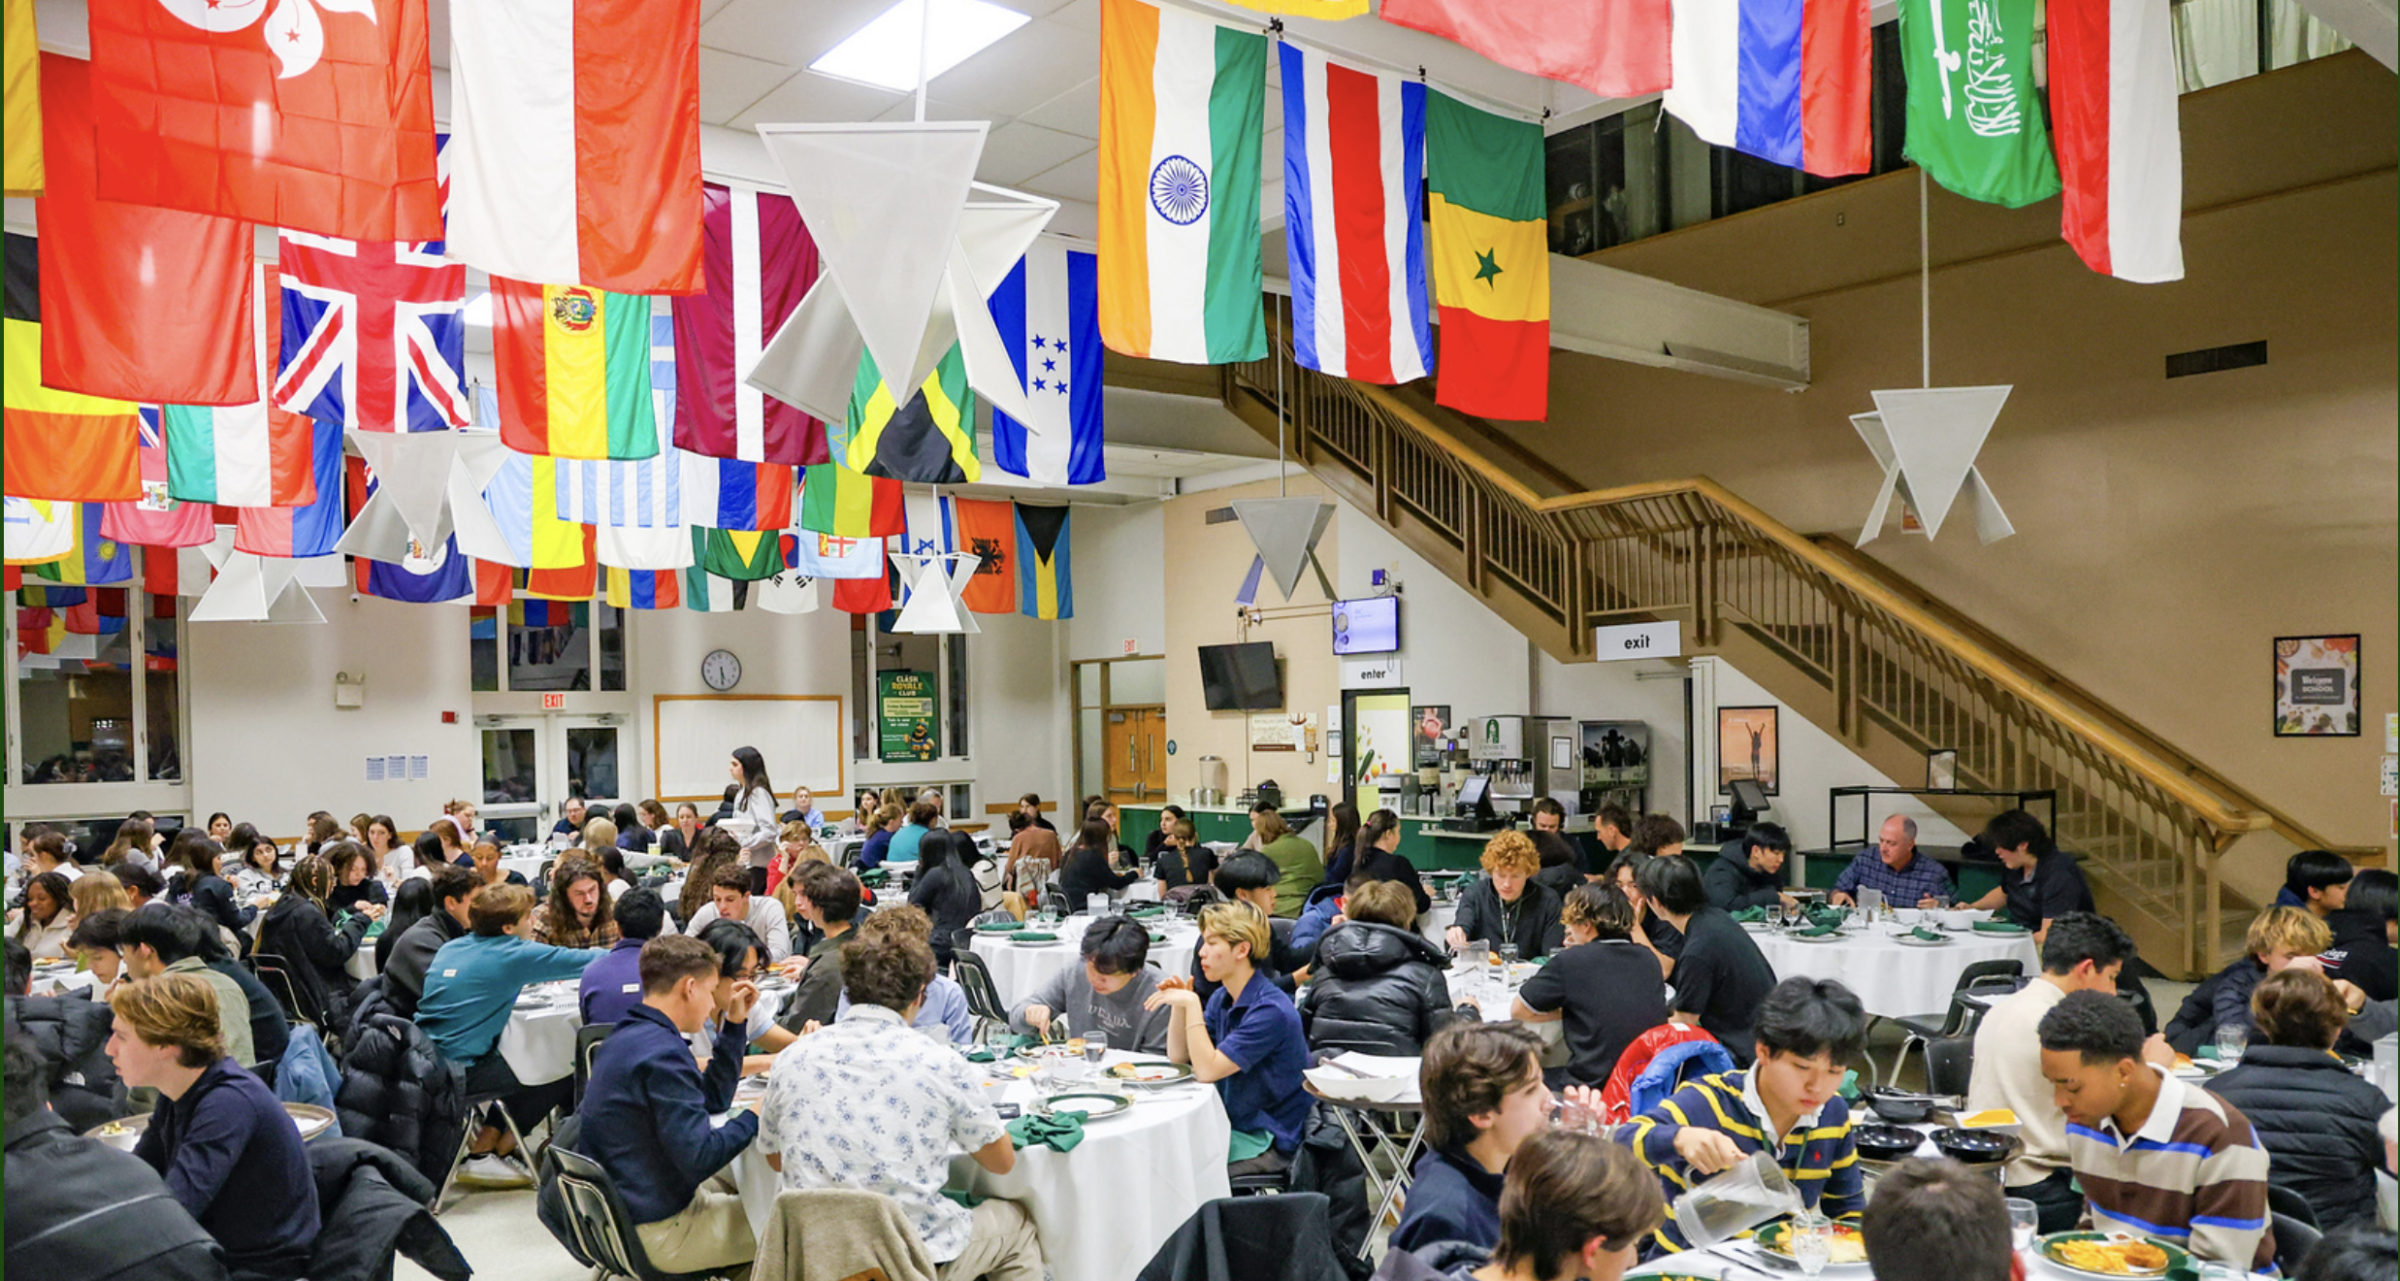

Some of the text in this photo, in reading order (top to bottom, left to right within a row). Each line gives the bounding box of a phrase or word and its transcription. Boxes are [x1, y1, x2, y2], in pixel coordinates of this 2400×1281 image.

[1624, 634, 1650, 649] exit
[896, 675, 919, 683] CLASH
[1361, 669, 1386, 679] enter
[891, 682, 923, 690] ROYALE
[544, 693, 564, 708] EXIT
